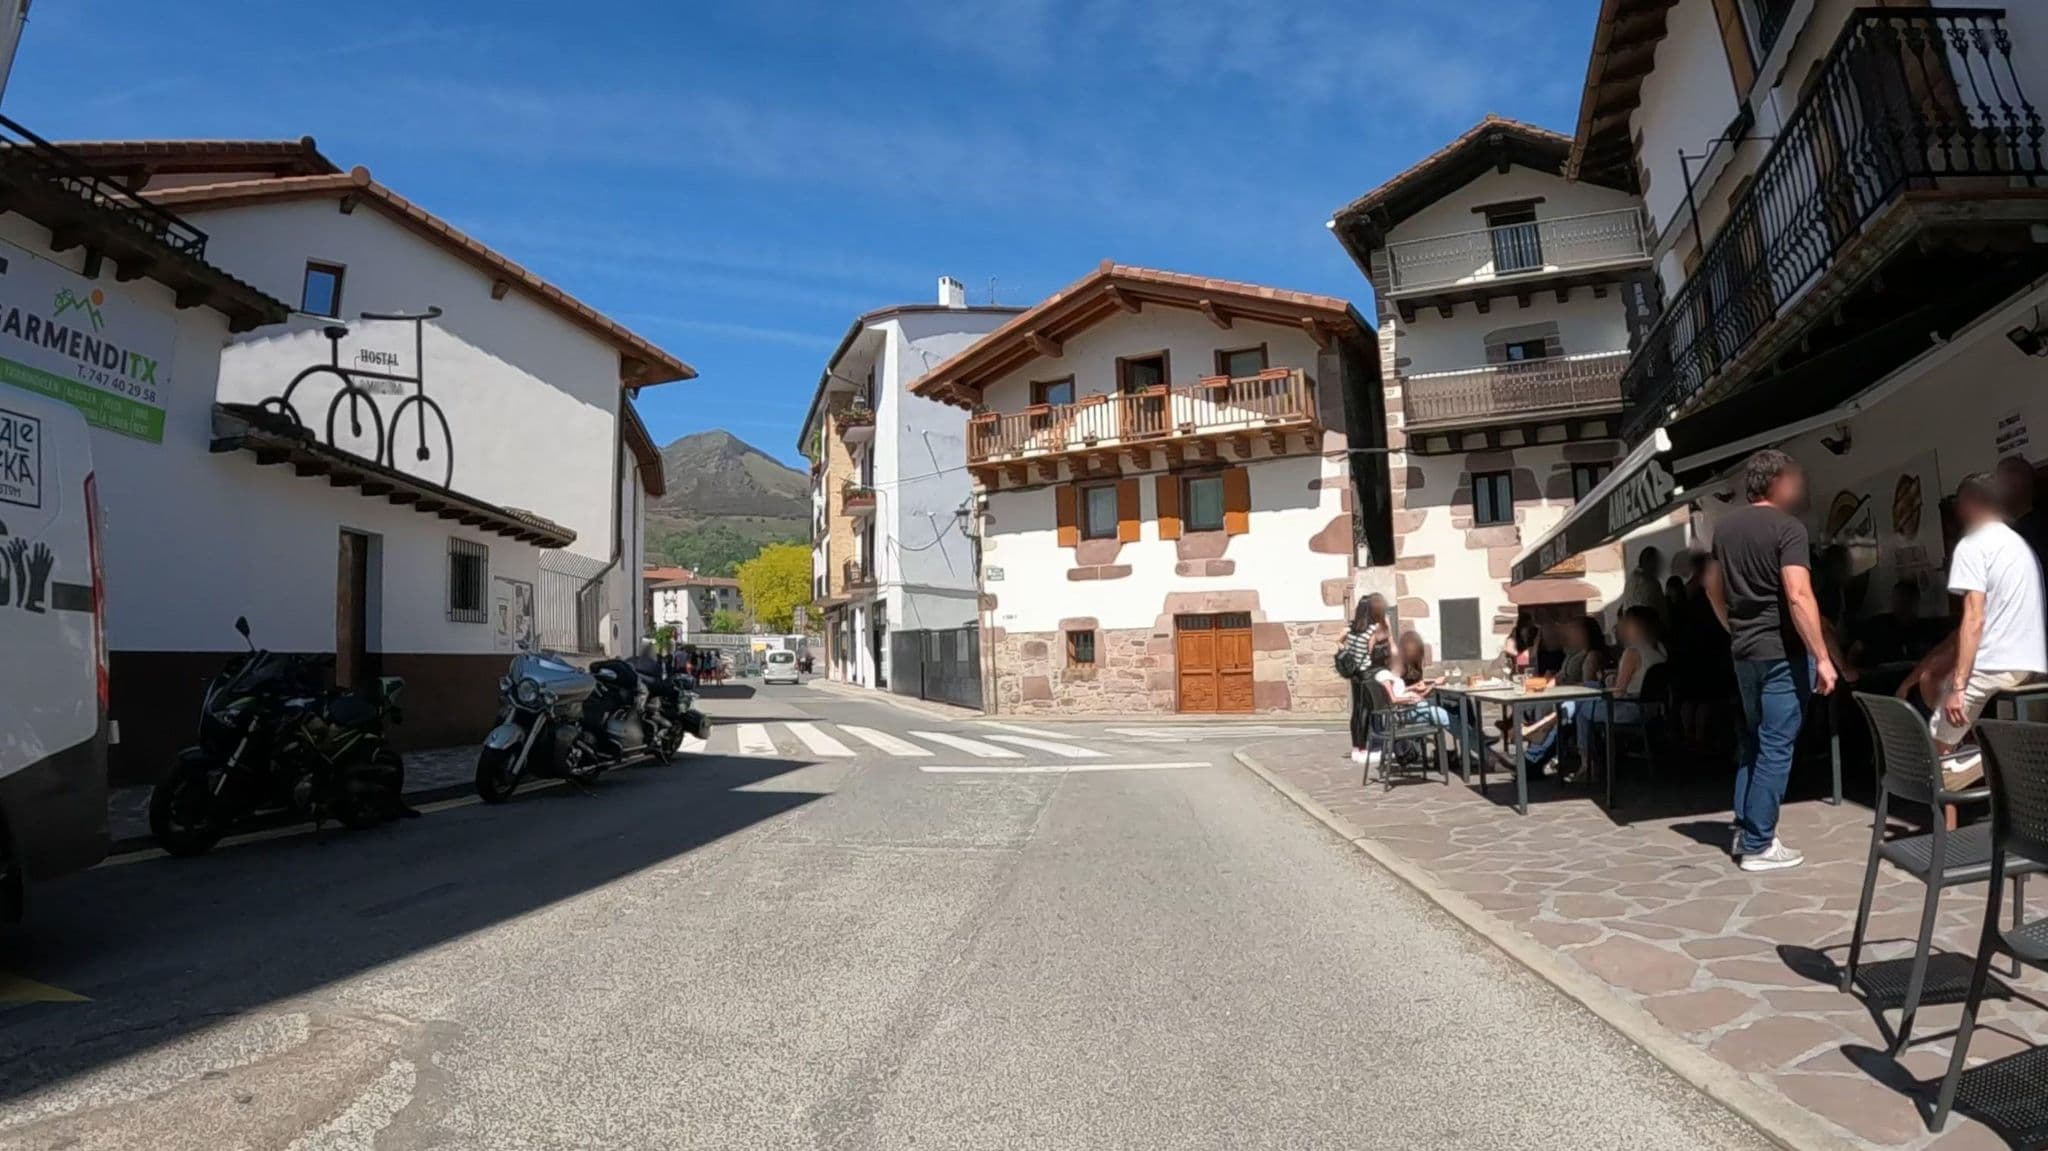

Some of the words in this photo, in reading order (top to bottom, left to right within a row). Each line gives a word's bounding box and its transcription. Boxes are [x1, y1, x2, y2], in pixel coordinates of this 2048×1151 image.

[0, 304, 158, 386] ARMENDITX
[360, 349, 399, 366] HOSTAL
[112, 377, 126, 392] 40
[127, 383, 142, 398] 29
[0, 449, 35, 487] KA
